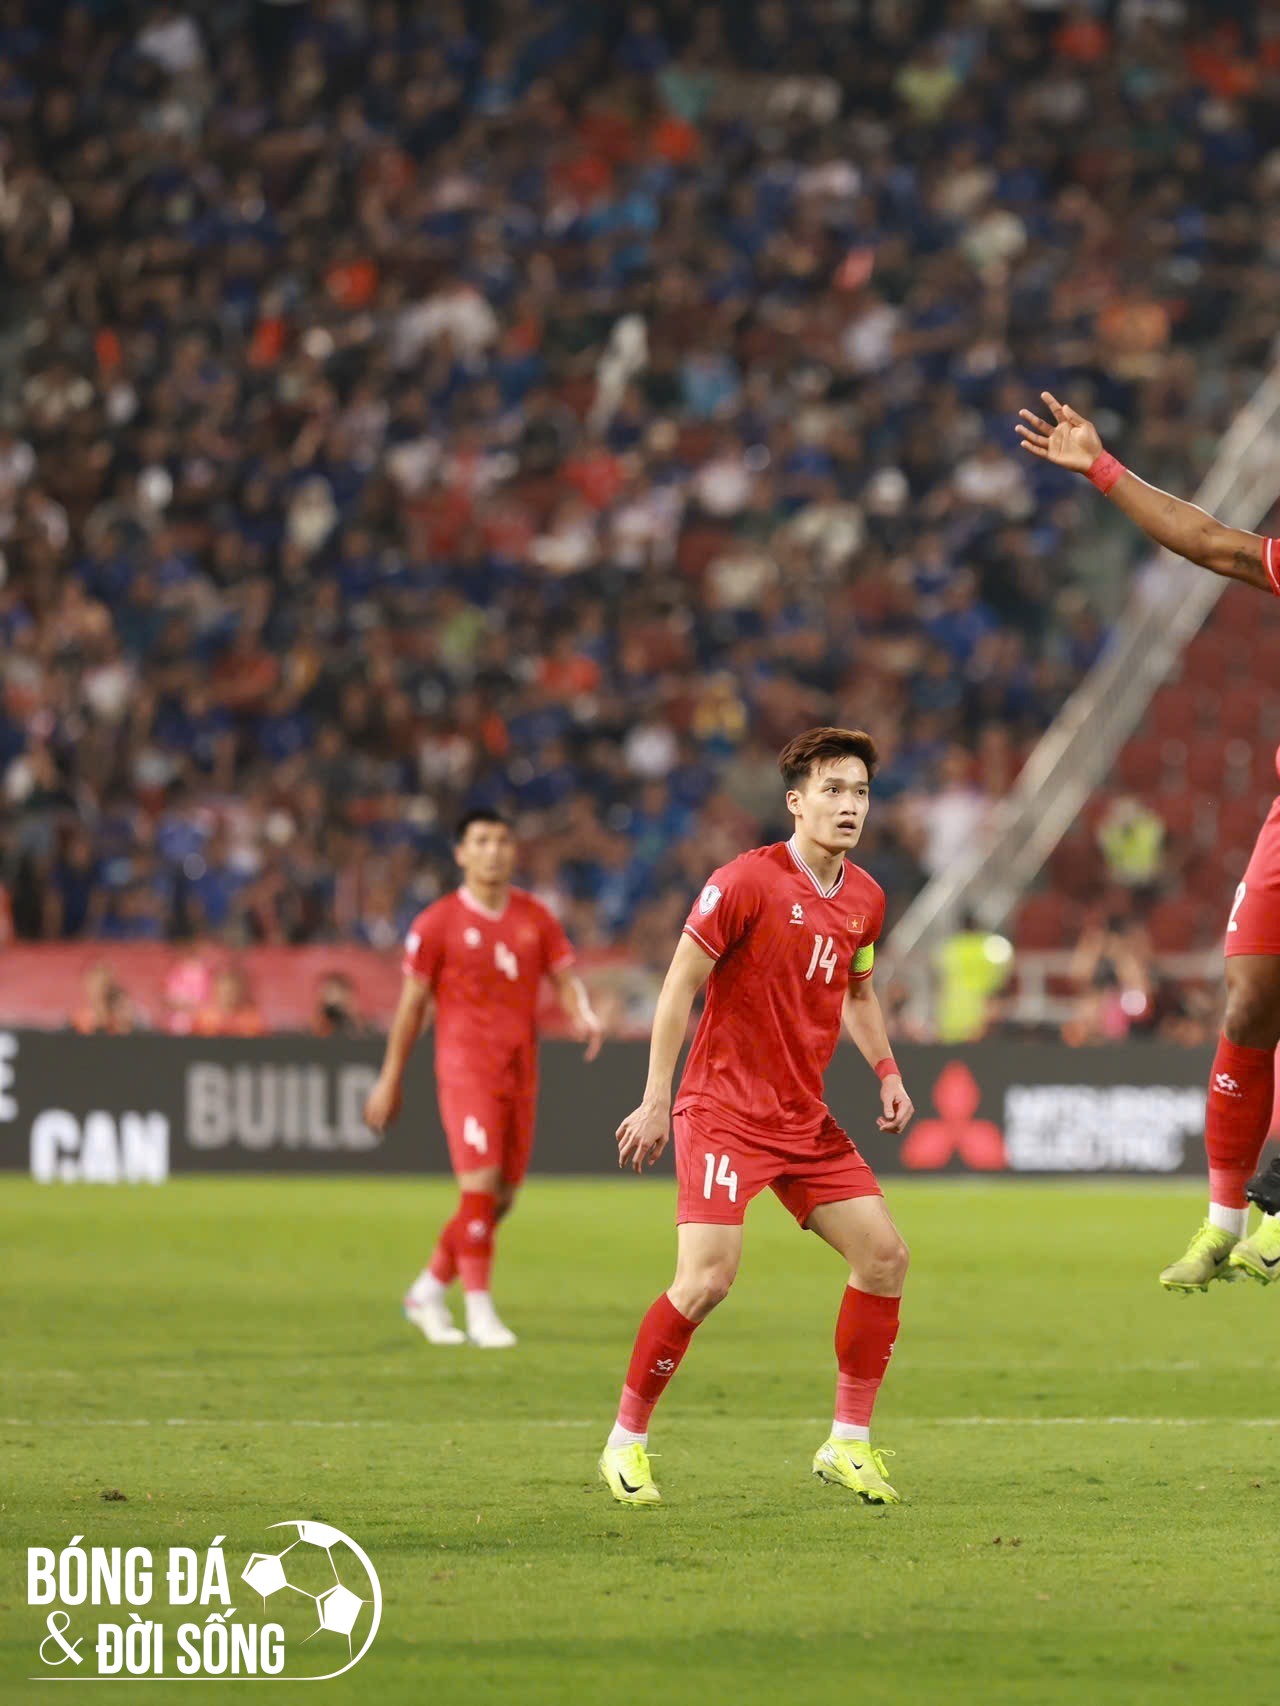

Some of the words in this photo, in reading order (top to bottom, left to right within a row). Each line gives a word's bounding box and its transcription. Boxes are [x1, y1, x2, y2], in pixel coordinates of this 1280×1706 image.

[494, 941, 519, 982] 4
[806, 934, 838, 984] 14
[186, 1063, 381, 1149] BUILD
[30, 1110, 170, 1184] CAN
[463, 1115, 488, 1155] 4
[703, 1153, 738, 1202] 14
